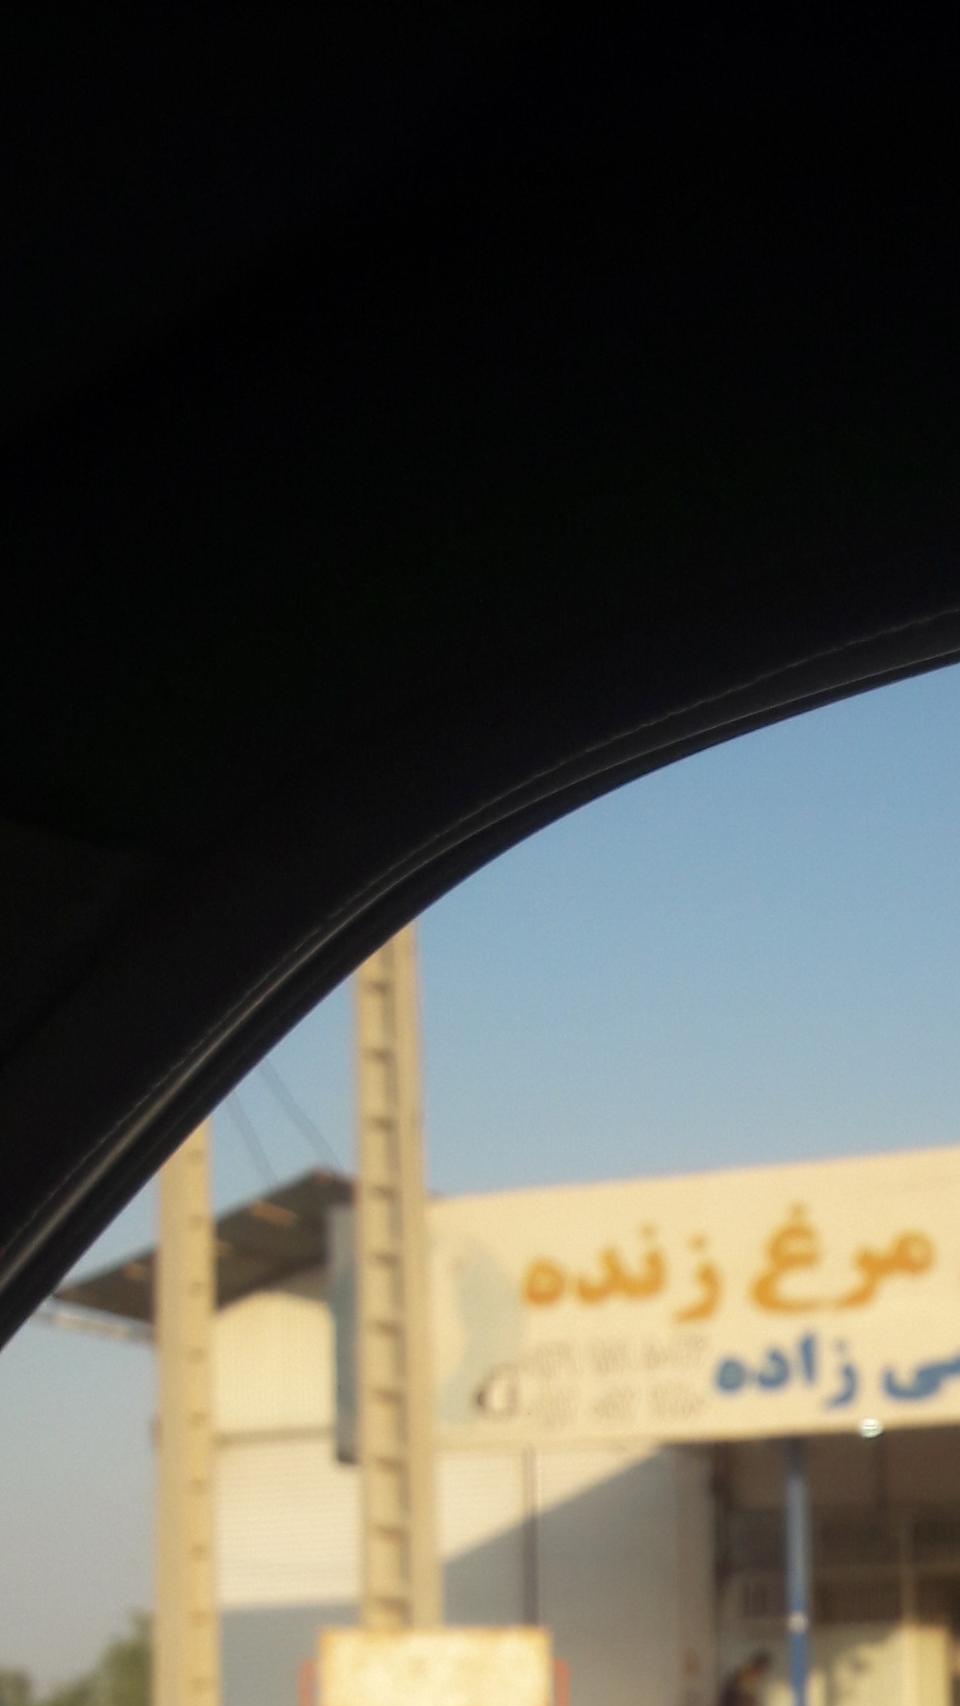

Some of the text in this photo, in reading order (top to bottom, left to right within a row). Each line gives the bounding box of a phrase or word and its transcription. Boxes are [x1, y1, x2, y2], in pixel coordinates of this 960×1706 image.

[521, 1222, 724, 1324] زنده
[749, 1202, 935, 1314] مرغ
[714, 1333, 859, 1408] زاده
